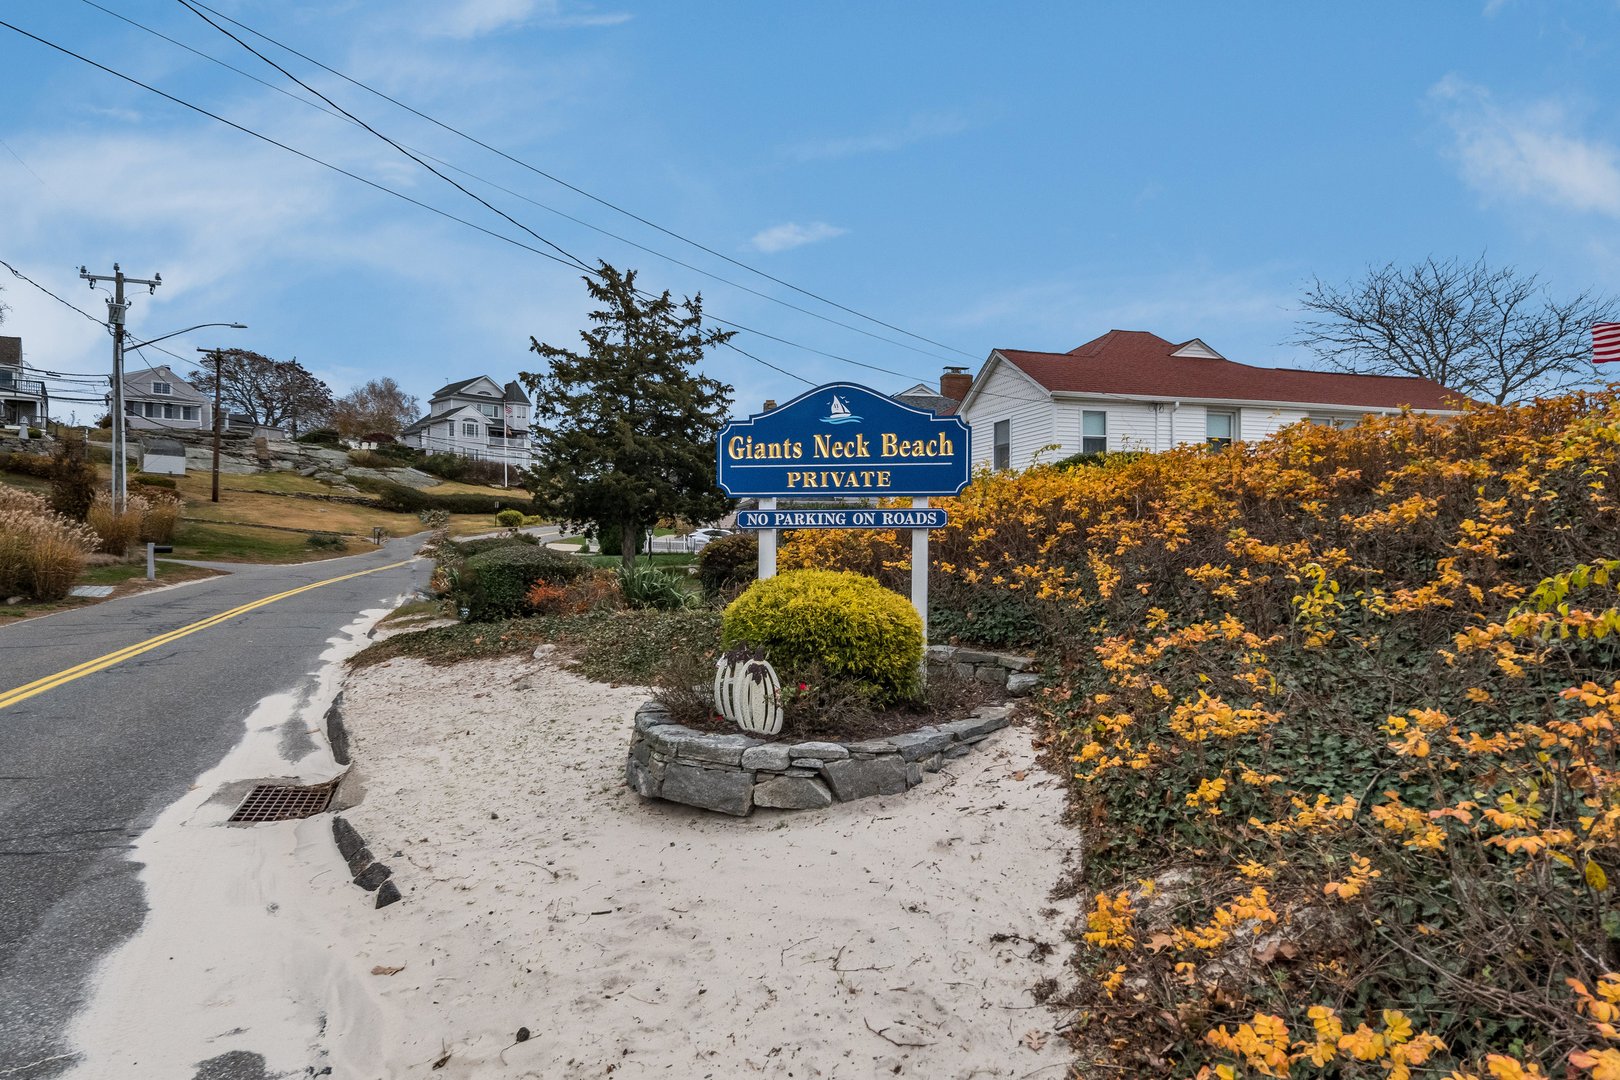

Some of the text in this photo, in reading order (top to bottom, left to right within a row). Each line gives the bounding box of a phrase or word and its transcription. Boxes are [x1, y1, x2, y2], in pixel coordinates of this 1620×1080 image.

[728, 431, 954, 460] Giants Neck Beach
[787, 470, 891, 488] PRIVATE
[746, 512, 937, 526] NO PARKING ON ROADS
